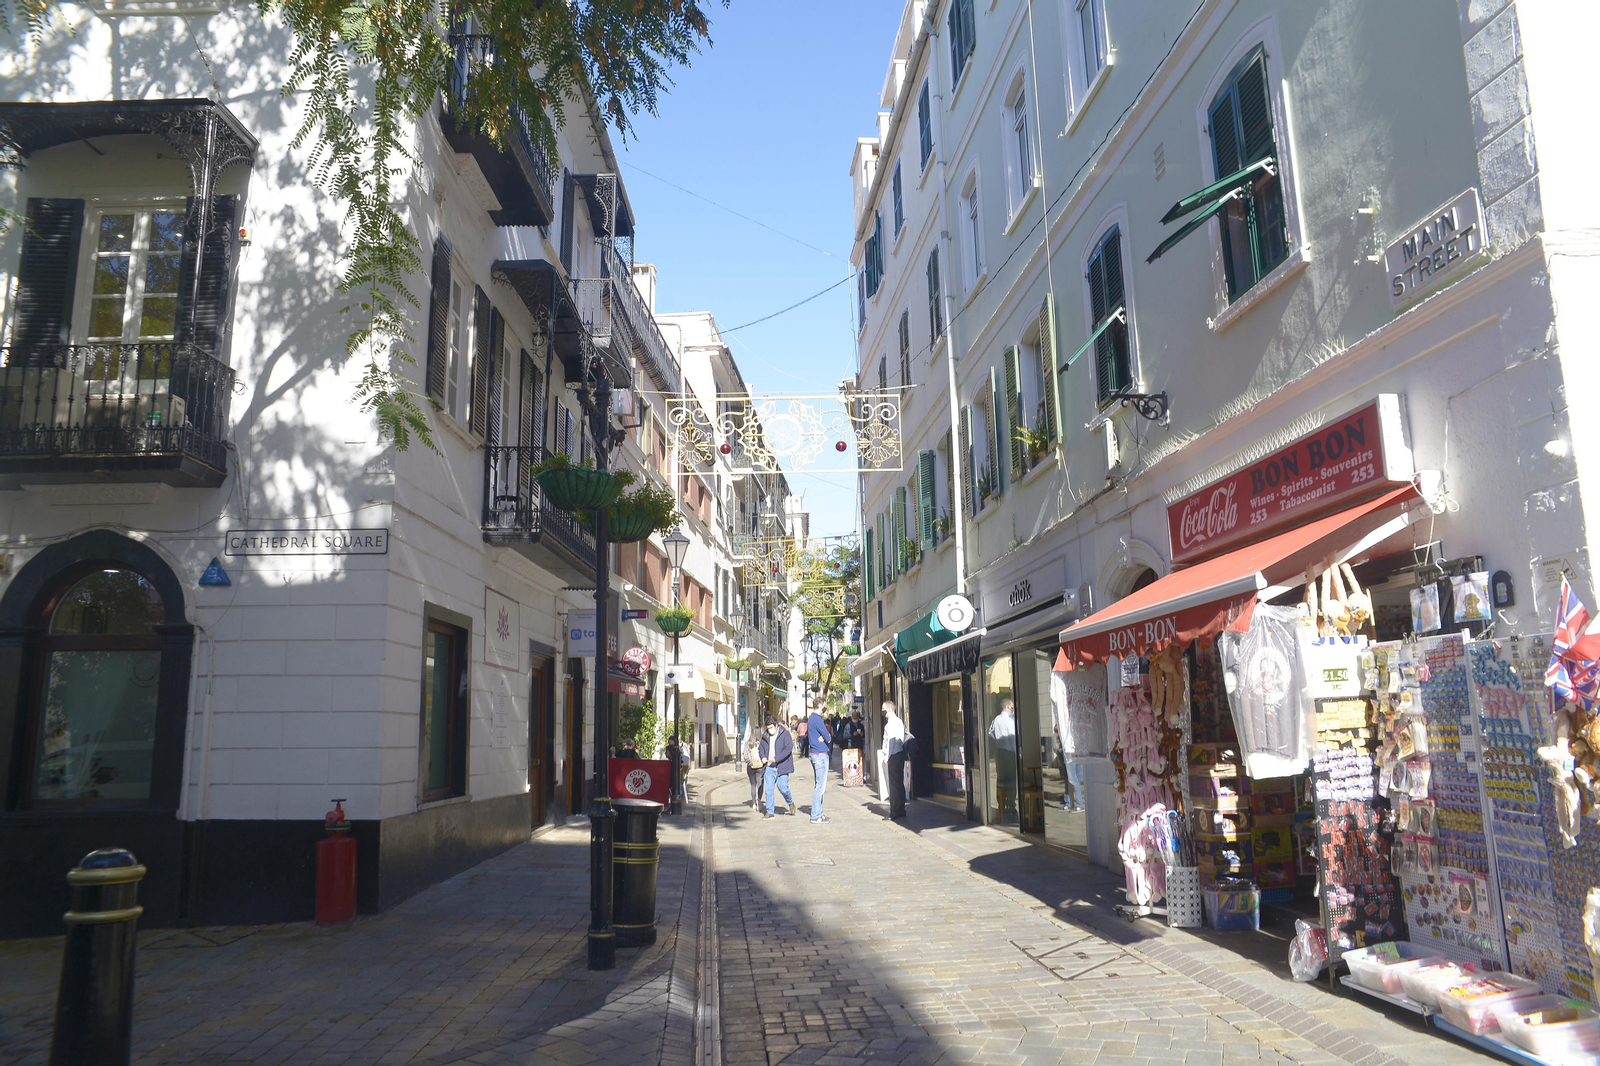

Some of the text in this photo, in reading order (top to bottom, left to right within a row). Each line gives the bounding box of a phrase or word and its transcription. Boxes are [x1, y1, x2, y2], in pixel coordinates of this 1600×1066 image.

[1402, 206, 1459, 264] MAIN
[1392, 222, 1477, 298] STREET
[1249, 417, 1366, 495] BON BON
[1249, 449, 1373, 509] Wines Spirits Souvenirs
[1250, 463, 1375, 525] 253 Tabacconist 253
[1189, 496, 1200, 507] Enjoy
[230, 535, 383, 549] CATHEDRAL SQUARE
[1542, 558, 1562, 566] WARNING
[1008, 579, 1032, 607] chök
[583, 628, 596, 640] ta
[626, 648, 644, 658] COSTA
[624, 663, 647, 674] COFFEE
[1323, 669, 1349, 681] £1.50
[629, 770, 647, 779] COSTA
[627, 783, 648, 794] COFFEE
